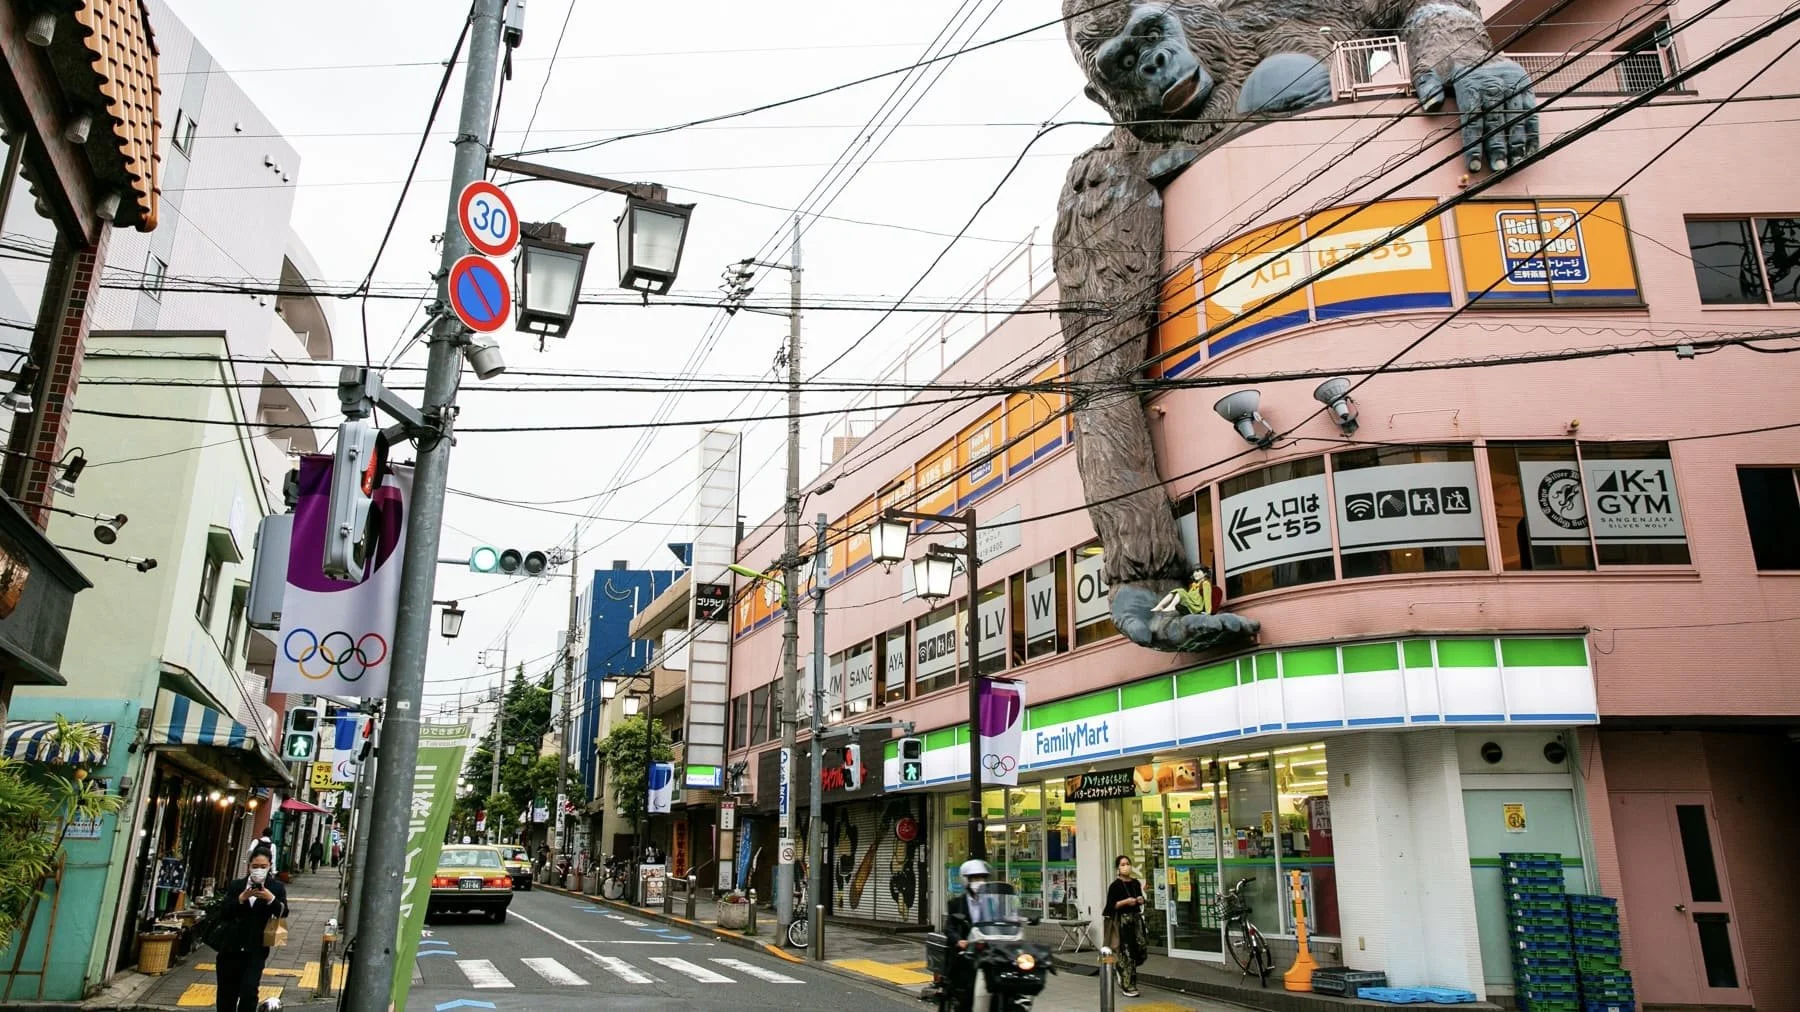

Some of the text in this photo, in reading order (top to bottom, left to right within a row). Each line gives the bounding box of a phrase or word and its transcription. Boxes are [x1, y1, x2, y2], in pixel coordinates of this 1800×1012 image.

[473, 199, 507, 239] 30
[1504, 217, 1552, 235] Hello
[1508, 237, 1577, 254] Storage
[1251, 259, 1291, 288] 入口
[1620, 469, 1668, 492] K-1
[1264, 492, 1320, 522] 入口は
[1597, 494, 1672, 515] GYM
[1266, 515, 1322, 542] こちら
[1036, 719, 1109, 758] FamilyMart
